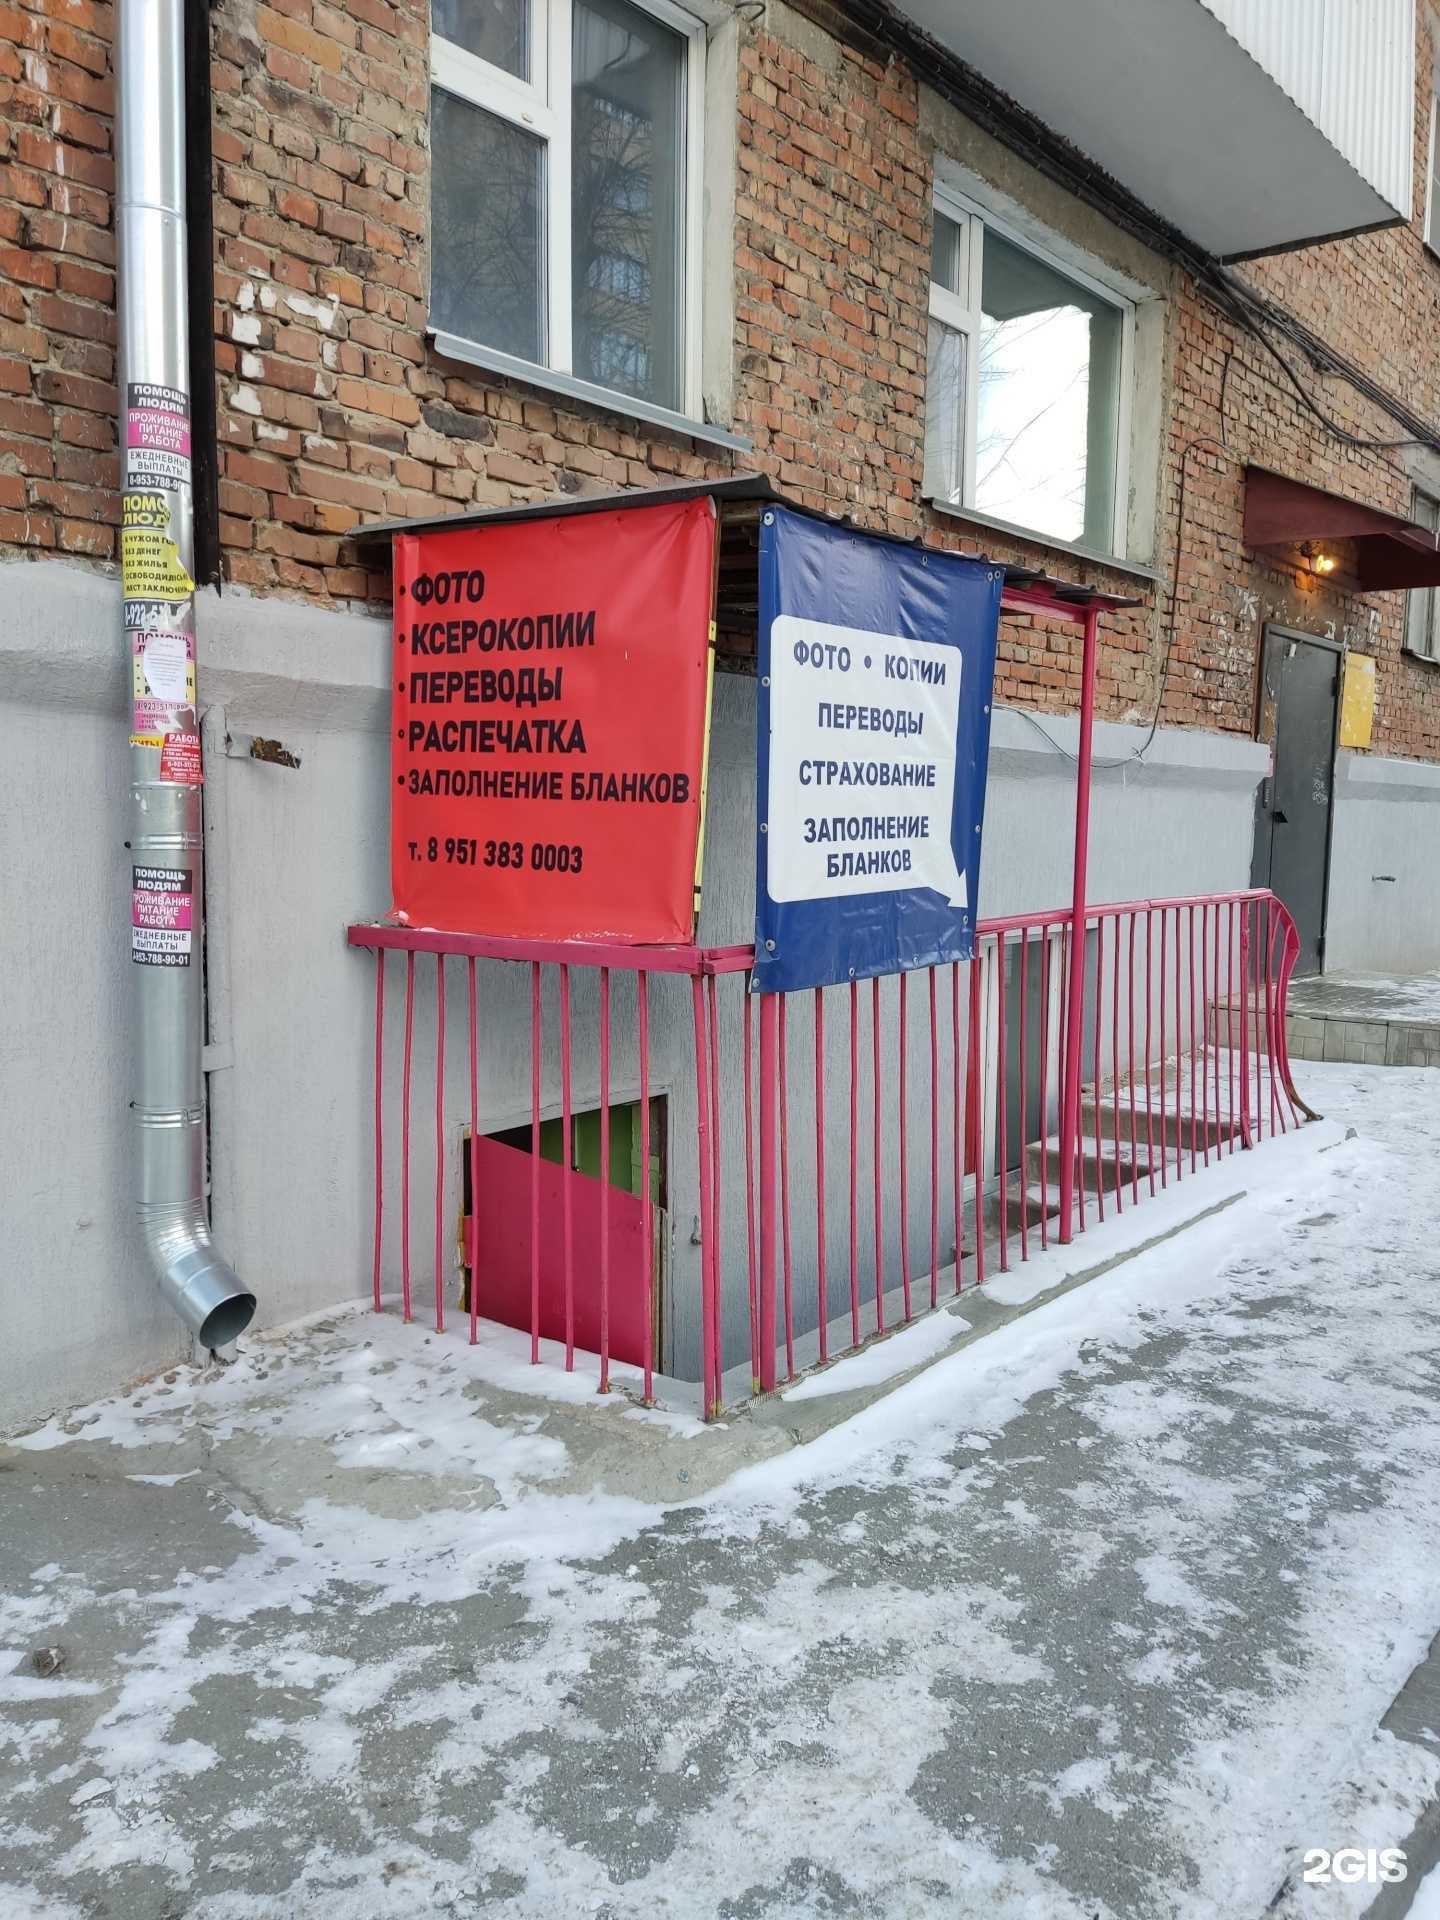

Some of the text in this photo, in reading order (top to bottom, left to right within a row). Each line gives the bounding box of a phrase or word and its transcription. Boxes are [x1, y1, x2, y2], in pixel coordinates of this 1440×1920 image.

[134, 384, 186, 404] ПОМОЩЬ
[138, 397, 184, 414] ЛЮДЯМ
[129, 412, 190, 432] ПРОЖИВАНИЕ
[138, 423, 183, 440] ПИТАНИЕ
[142, 434, 181, 449] РАБОТА
[130, 451, 188, 469] ЕЖЕДНЕВНЫЕ
[137, 461, 183, 476] ВЫПЛАТЫ
[411, 569, 485, 606] ФОТО
[411, 611, 596, 655] КСЕРОКОПИИ
[793, 639, 946, 686] ФОТО КОПИИ
[410, 667, 563, 708] ПЕРЕВОДЫ
[818, 702, 924, 738] ПЕРЕВОДЫ
[409, 719, 587, 753] РАСПЕЧАТКА
[799, 759, 936, 787] СТРАХОВАНИЕ
[409, 769, 690, 803] ЗАПОЛНЕНИЕ БЛАНКОВ
[804, 815, 930, 843] ЗАПОЛНЕНИЕ
[427, 837, 438, 862] 8
[445, 837, 477, 865] 951
[483, 841, 523, 869] 383
[531, 843, 583, 873] 0003
[827, 849, 912, 878] БЛАНКОВ
[135, 868, 186, 881] ПОМОЩЬ
[137, 880, 181, 892] ЛЮДЯМ
[137, 904, 180, 916] ПИТАНИЕ
[139, 915, 176, 925] РАБОТА
